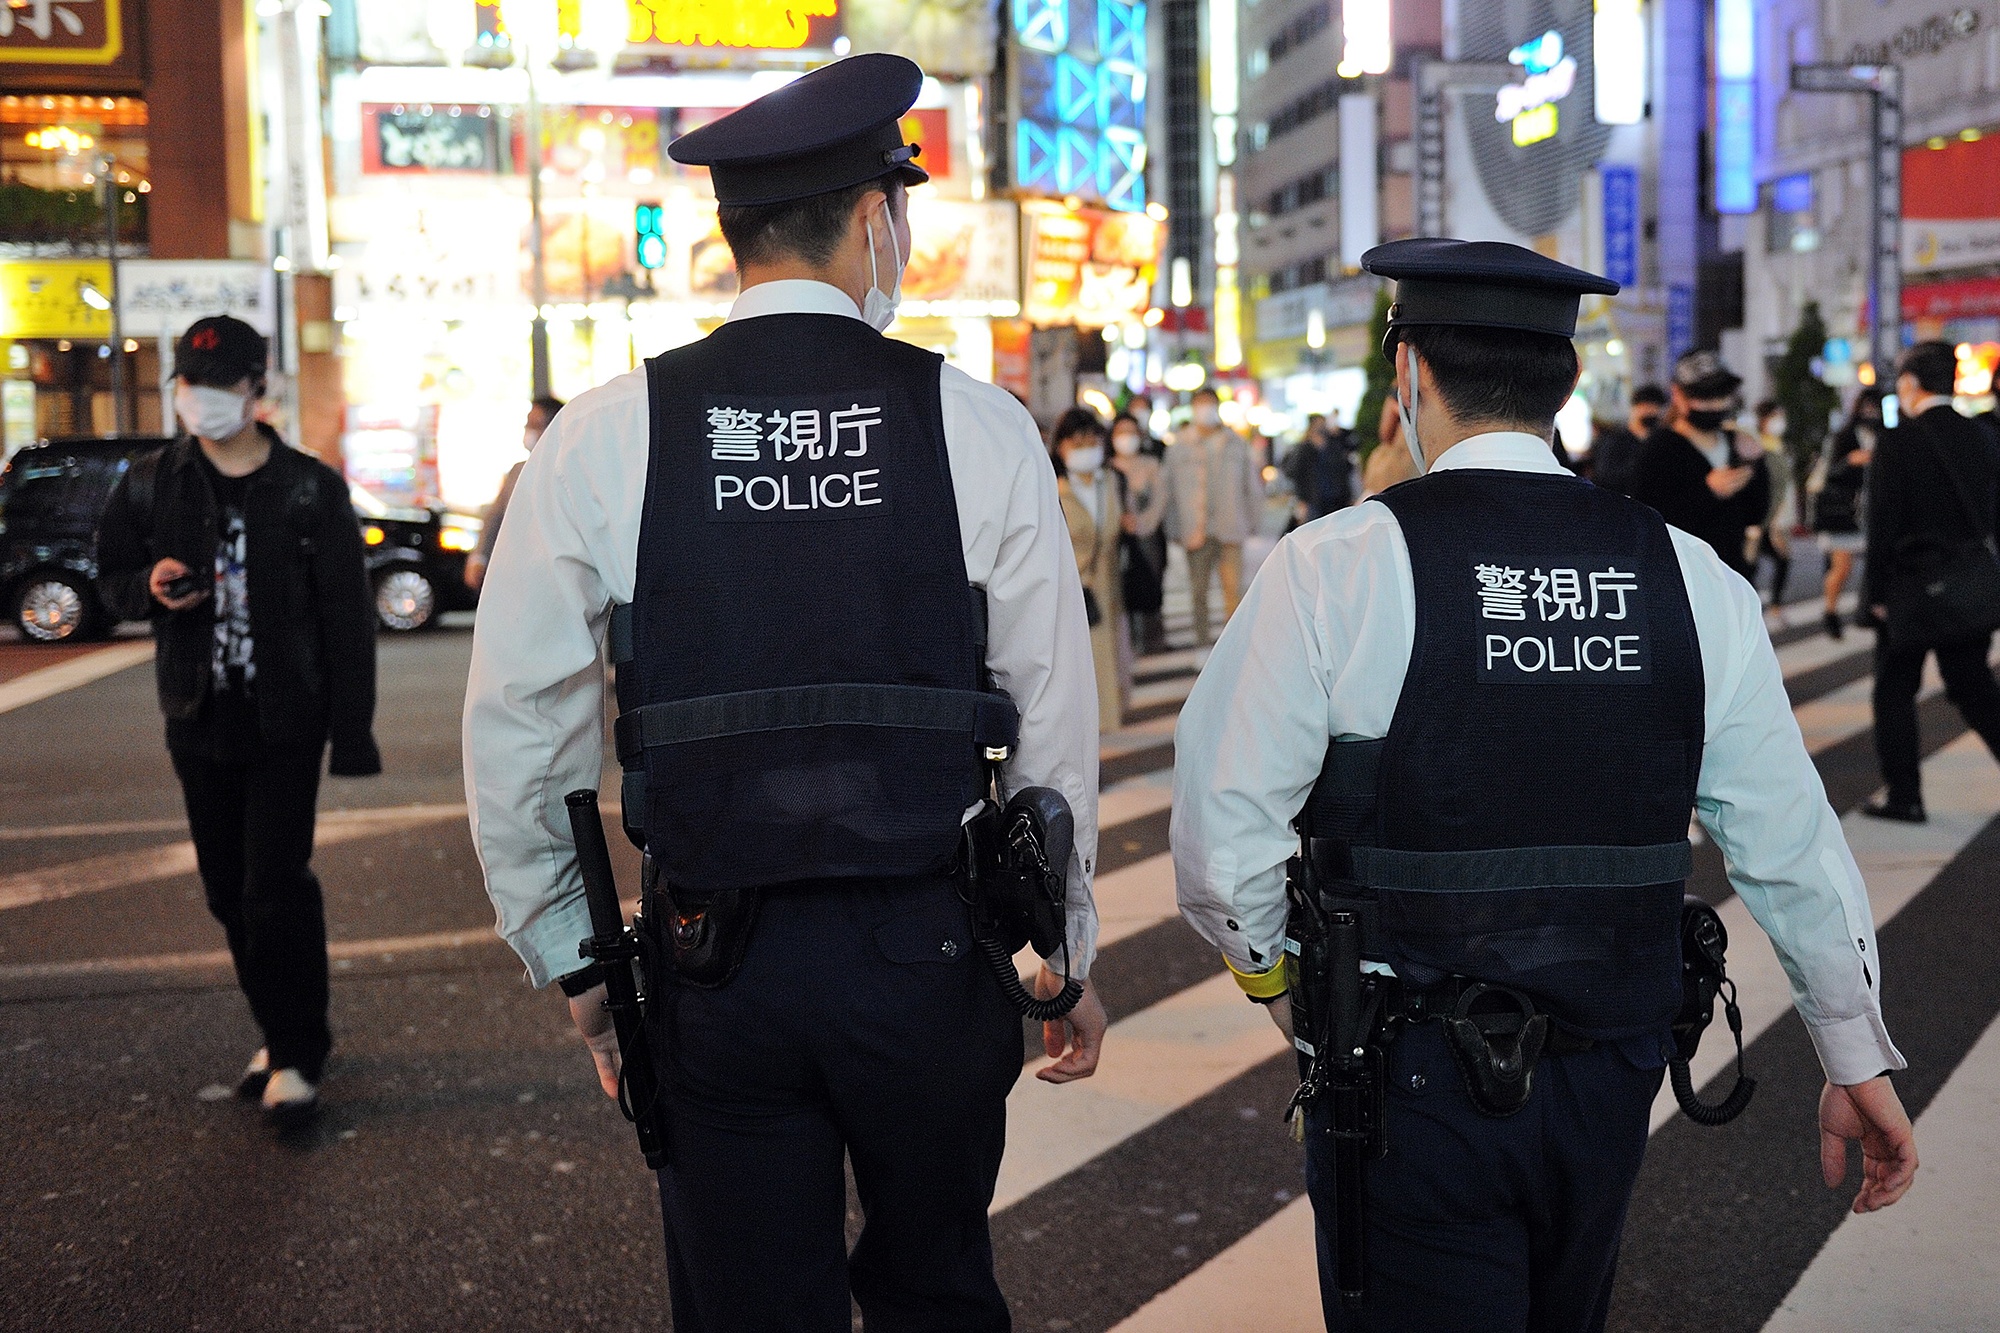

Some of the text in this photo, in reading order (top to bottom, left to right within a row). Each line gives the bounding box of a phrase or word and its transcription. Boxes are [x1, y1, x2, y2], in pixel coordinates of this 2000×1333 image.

[706, 403, 883, 462] 警視庁
[714, 468, 883, 511] POLICE
[1474, 563, 1638, 622] 警視庁
[1485, 634, 1642, 673] POLICE
